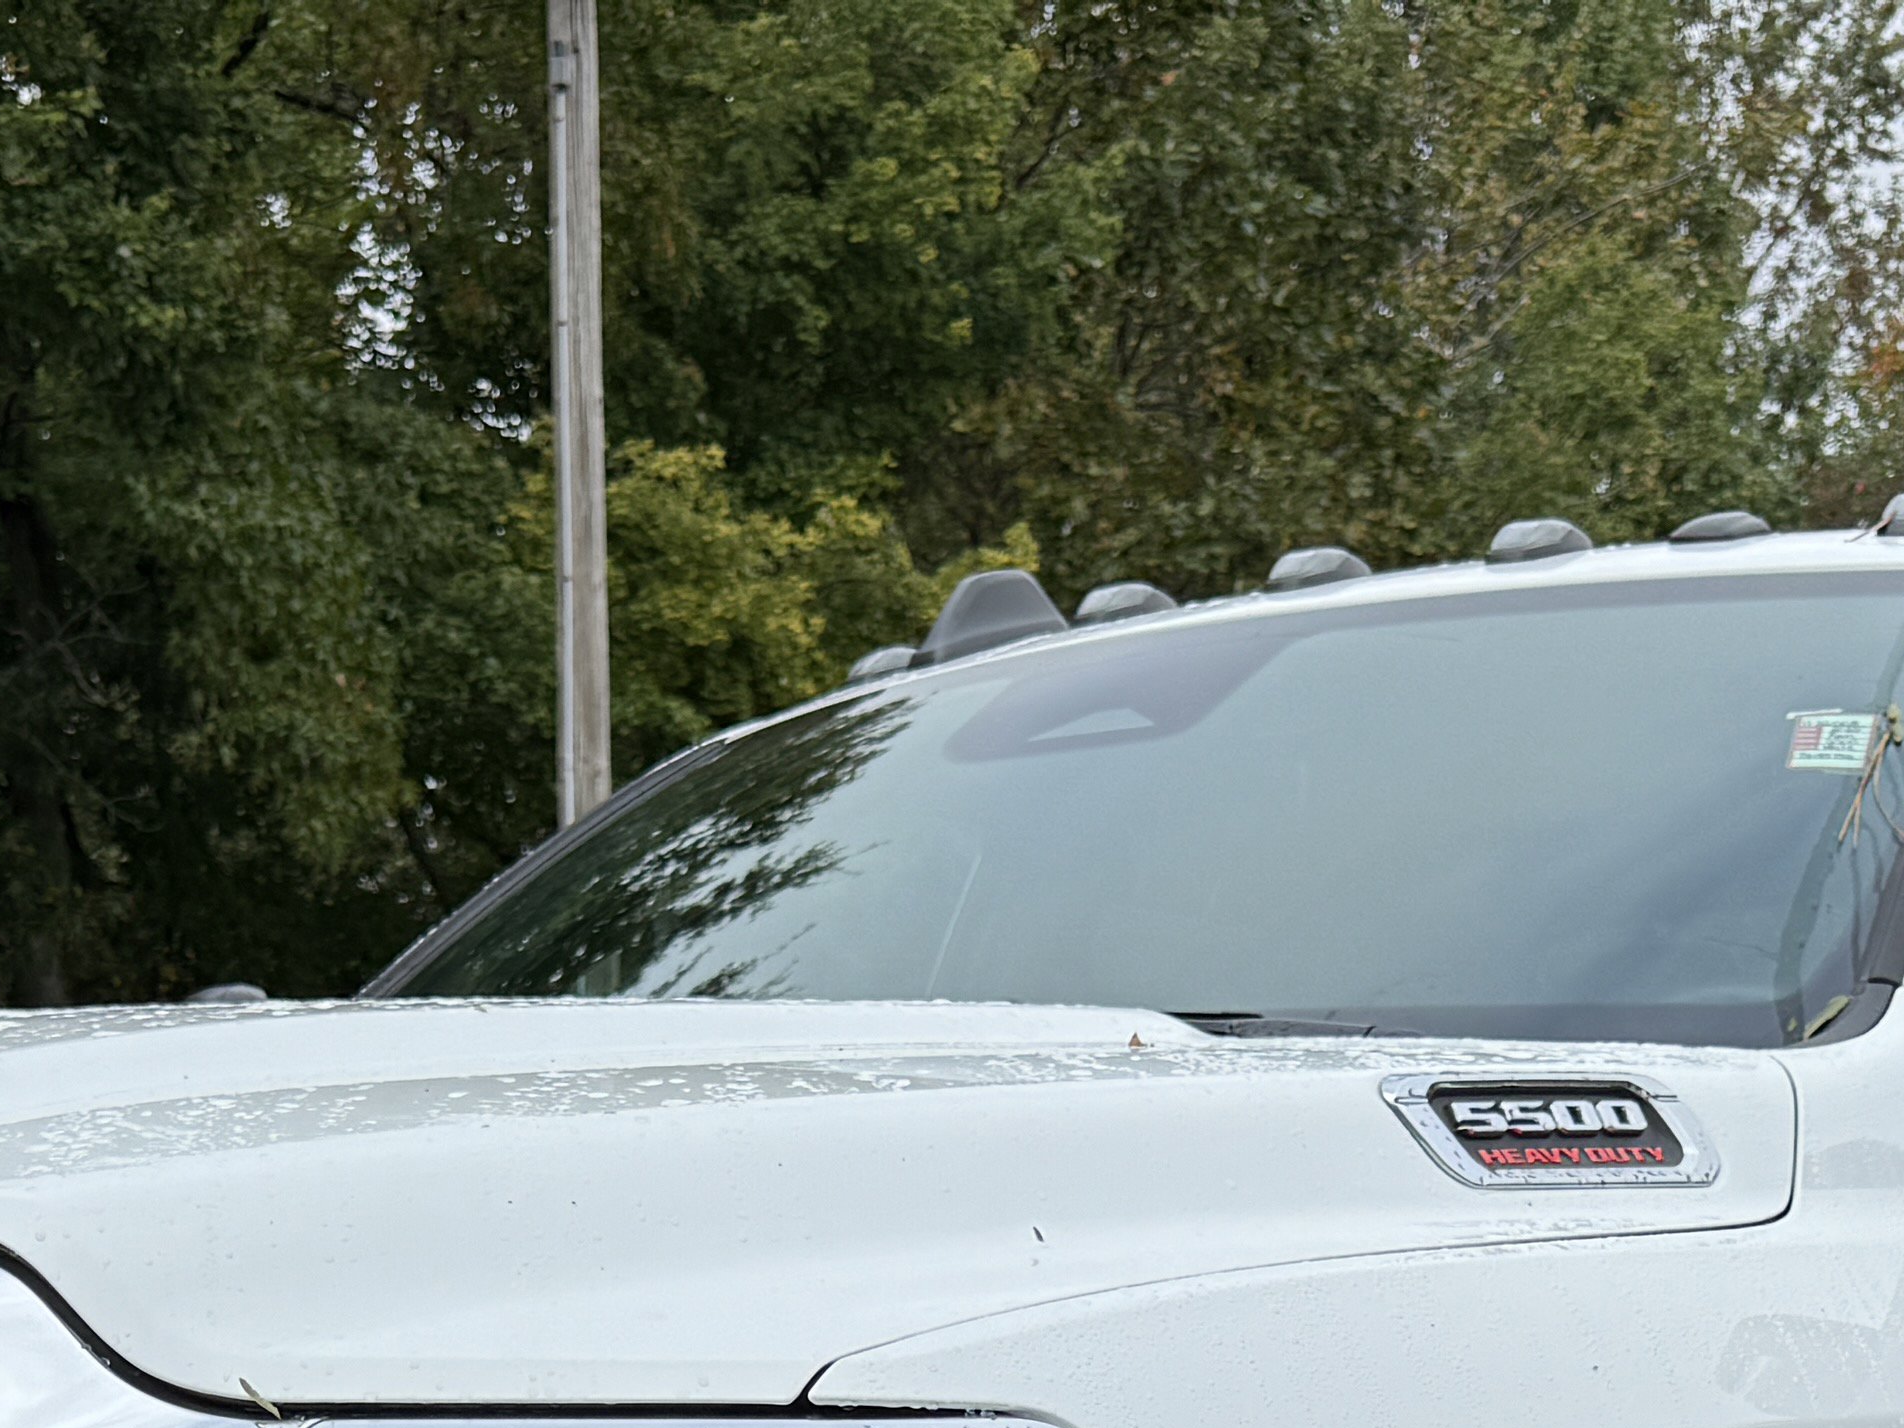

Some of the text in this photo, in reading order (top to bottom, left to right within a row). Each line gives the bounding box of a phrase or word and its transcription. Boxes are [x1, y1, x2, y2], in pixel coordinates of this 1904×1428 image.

[1450, 1100, 1648, 1138] 5500
[1477, 1147, 1665, 1165] HEAVY DUTY
